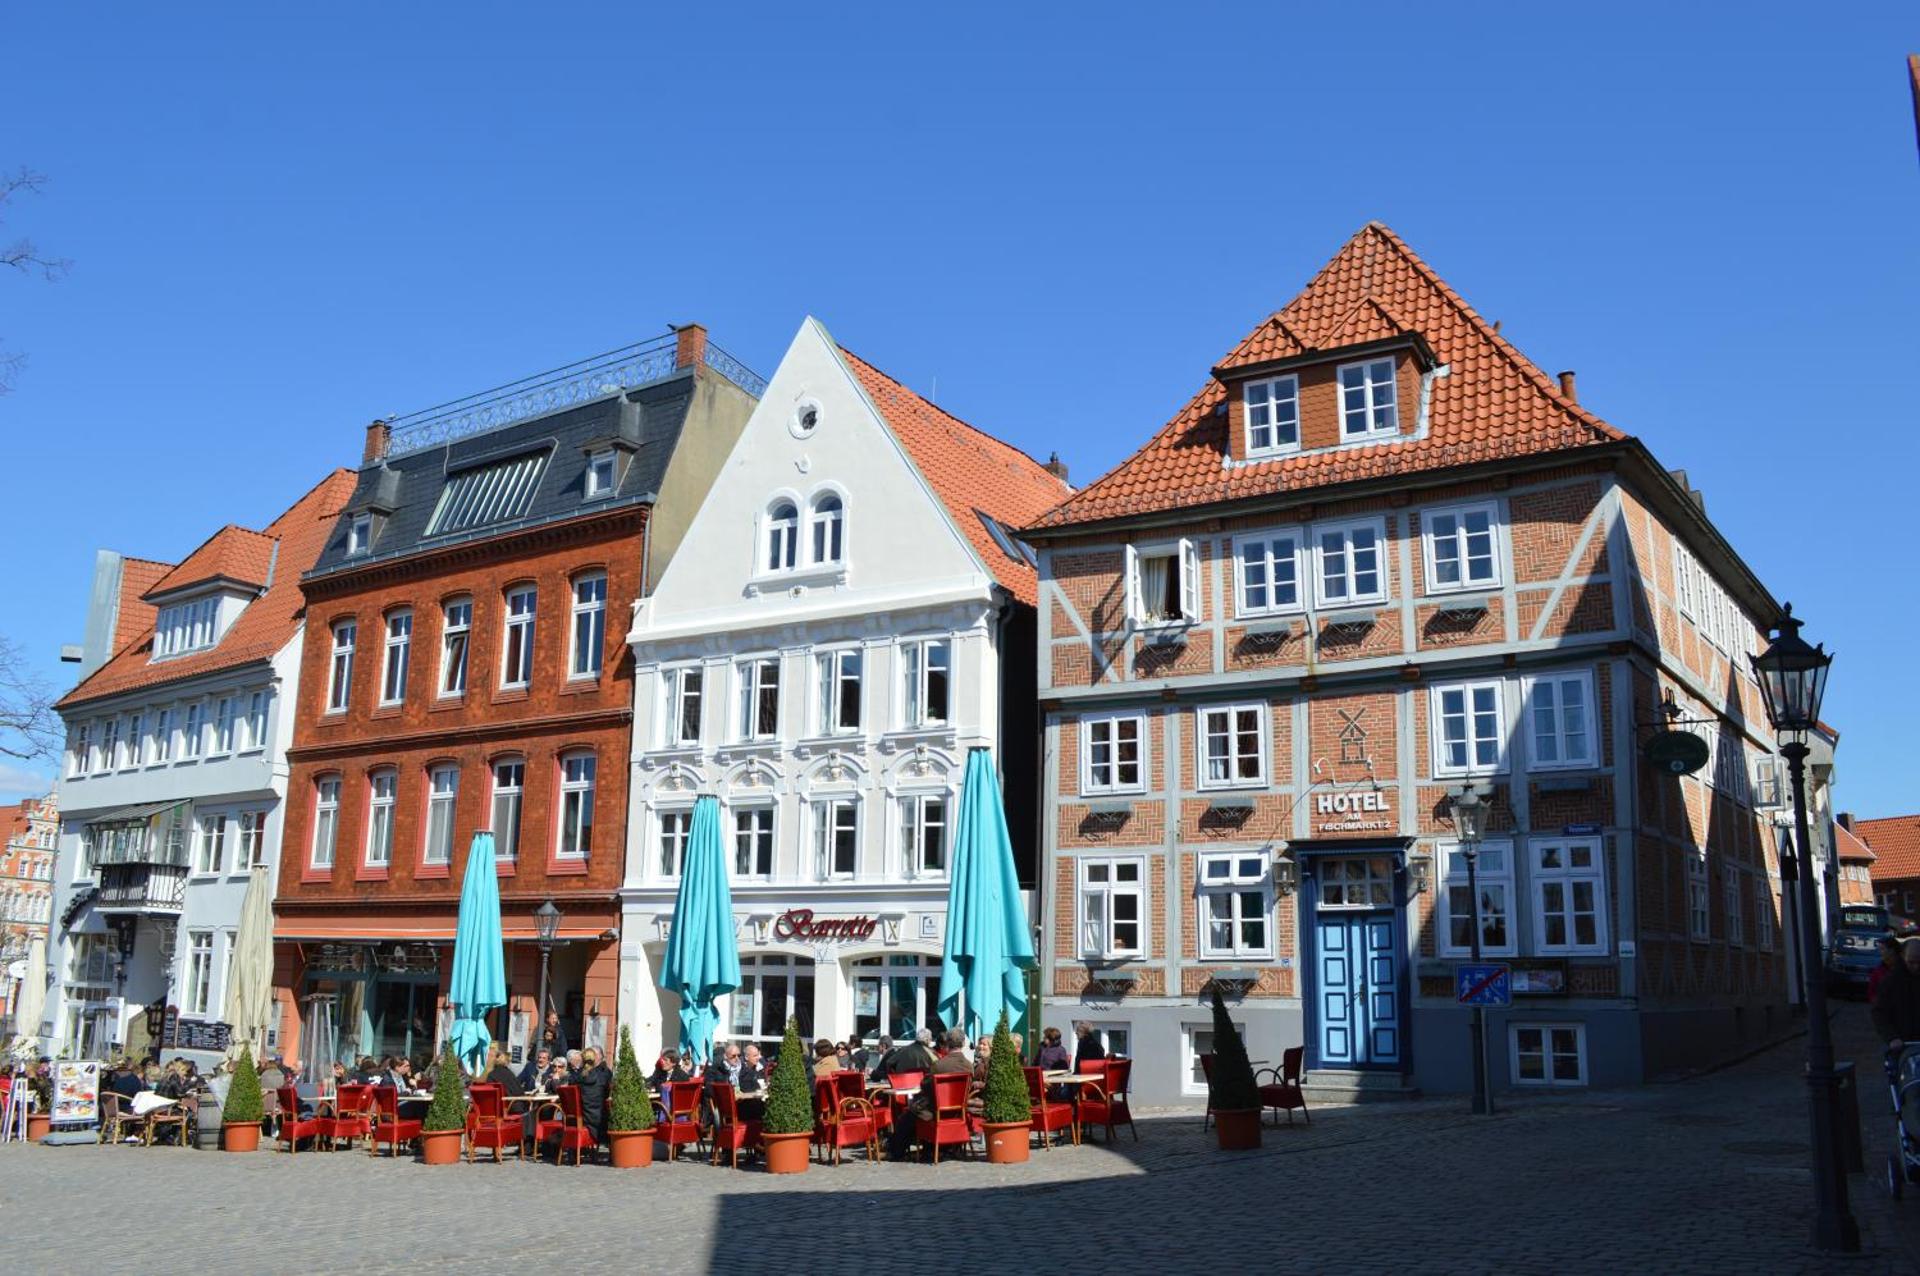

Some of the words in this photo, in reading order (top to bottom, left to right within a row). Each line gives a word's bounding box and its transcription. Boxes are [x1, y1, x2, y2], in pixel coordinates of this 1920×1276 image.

[1317, 791, 1391, 814] HOTEL
[1346, 812, 1361, 821] AM
[1318, 820, 1383, 833] FISCHMARKT
[774, 908, 878, 939] Barretto
